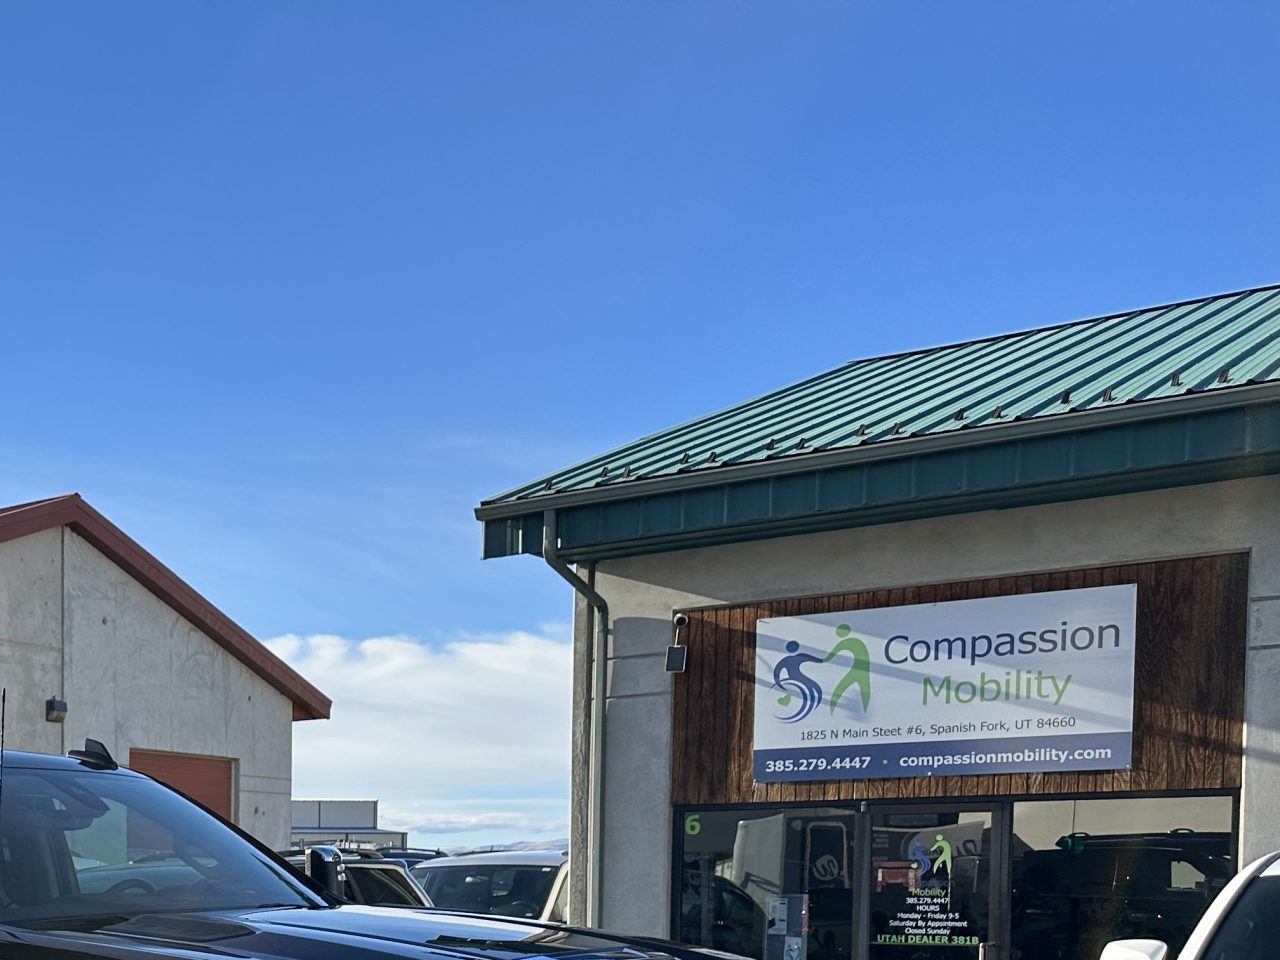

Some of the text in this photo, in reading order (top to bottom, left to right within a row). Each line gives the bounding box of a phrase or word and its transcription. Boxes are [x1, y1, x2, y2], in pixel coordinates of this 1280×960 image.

[884, 621, 1120, 665] Compassion
[922, 669, 1072, 706] Mobility
[800, 716, 1076, 741] 1825 N Main Steet #6, Spanish Fork, UT 84660
[765, 747, 1112, 772] 385.279.4447 compassionmobility.com
[684, 814, 701, 835] 6
[912, 888, 946, 897] Mobility
[916, 904, 940, 912] HOURS
[897, 912, 921, 920] Monday
[927, 912, 947, 920] Friday
[927, 920, 968, 928] Appointment
[927, 927, 951, 935] Sunday
[877, 934, 905, 943] UTAH
[908, 934, 949, 944] DEALER
